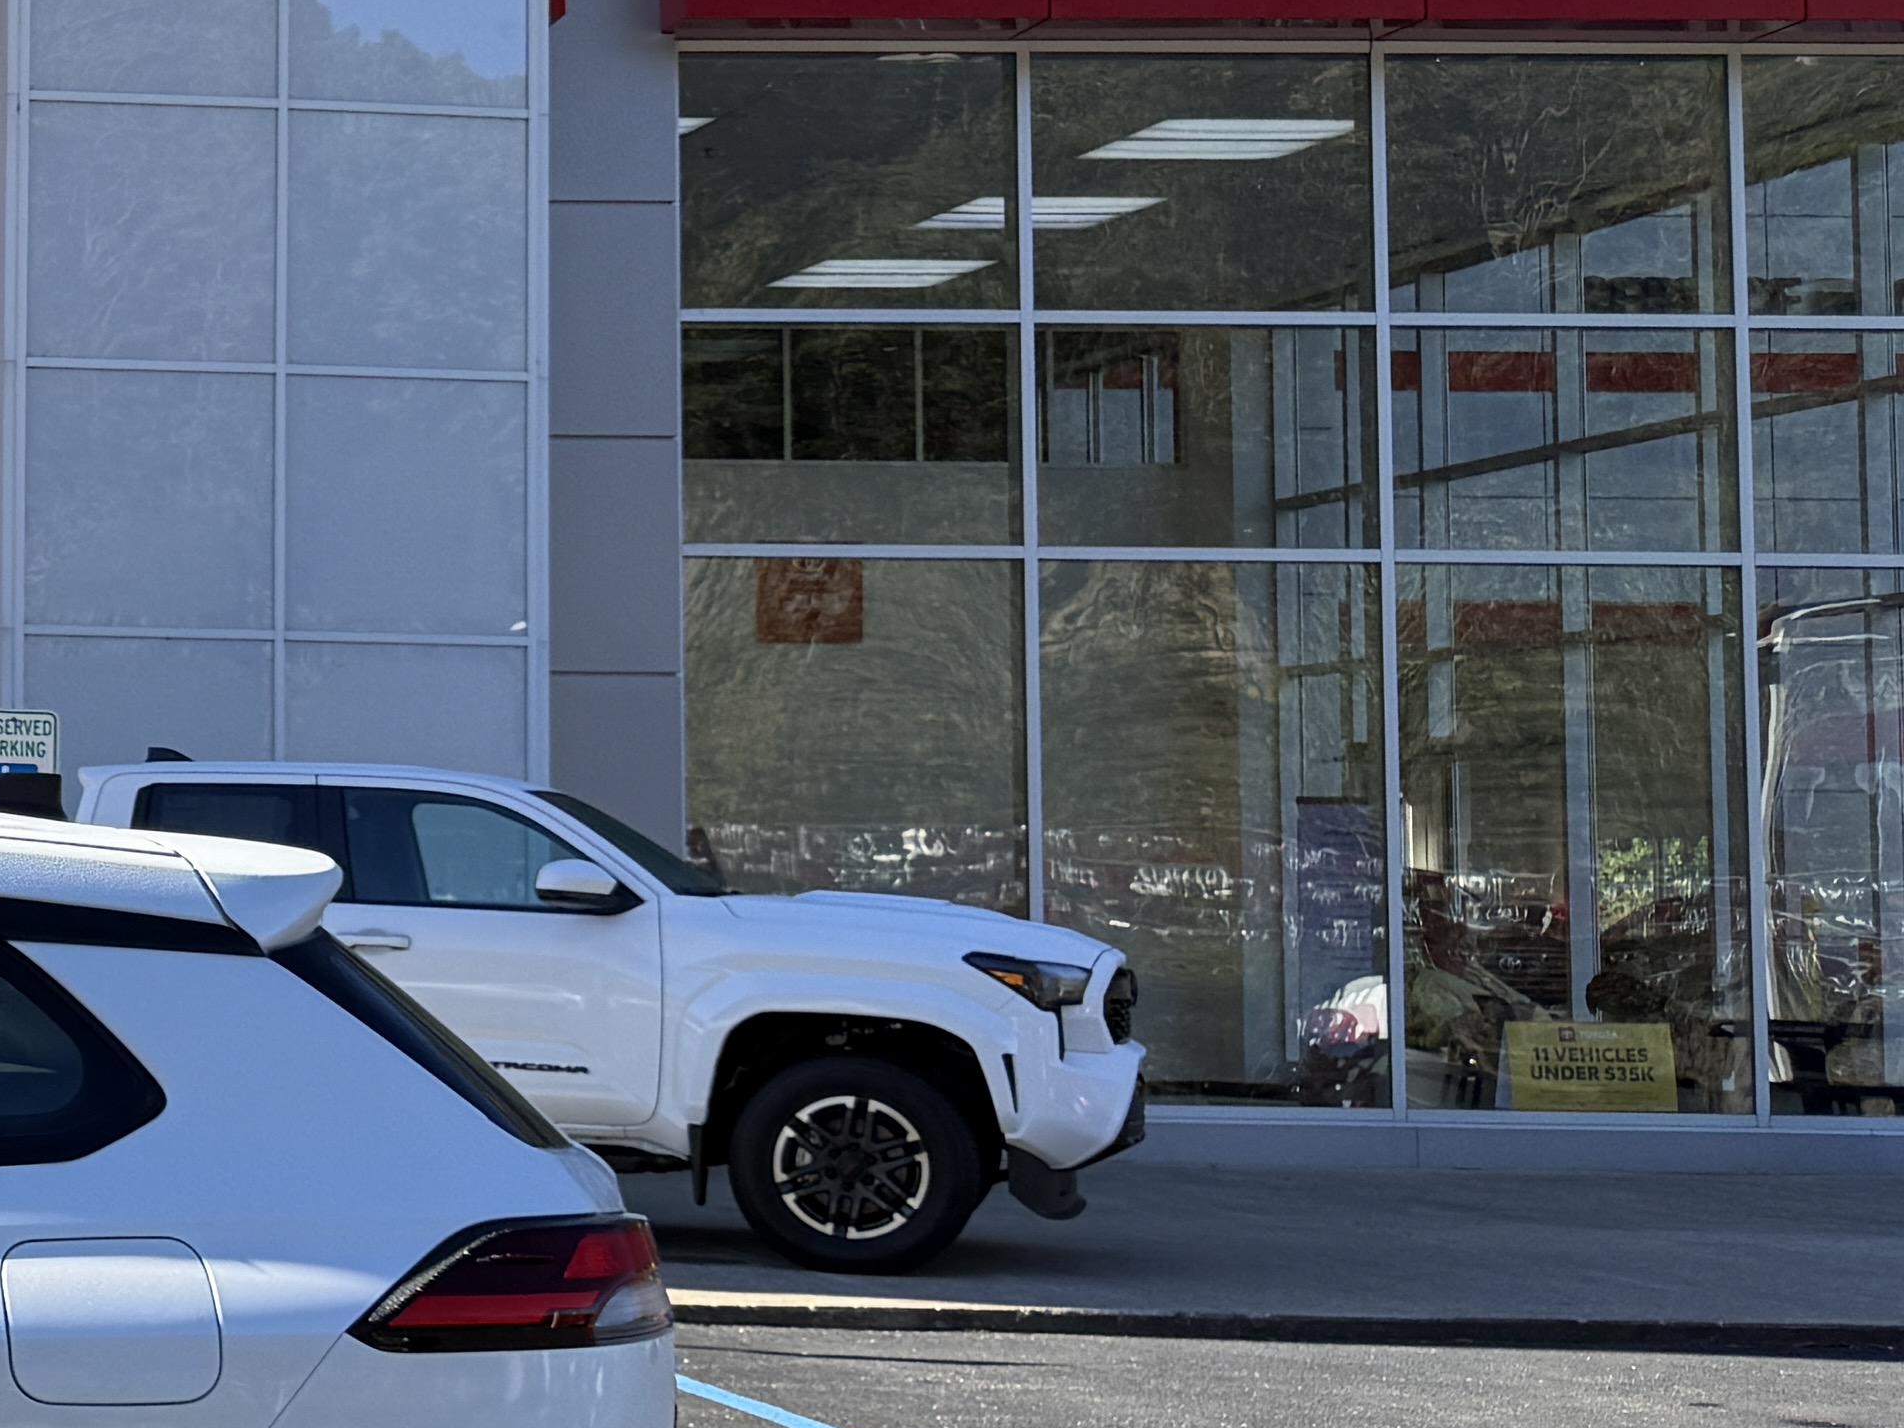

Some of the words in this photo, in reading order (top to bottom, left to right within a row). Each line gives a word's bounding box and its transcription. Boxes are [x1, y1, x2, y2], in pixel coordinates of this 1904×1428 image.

[1532, 1047, 1549, 1062] 11
[1553, 1047, 1649, 1063] VEHICLES
[1530, 1065, 1600, 1081] UNDER
[1604, 1065, 1656, 1082] $35K
